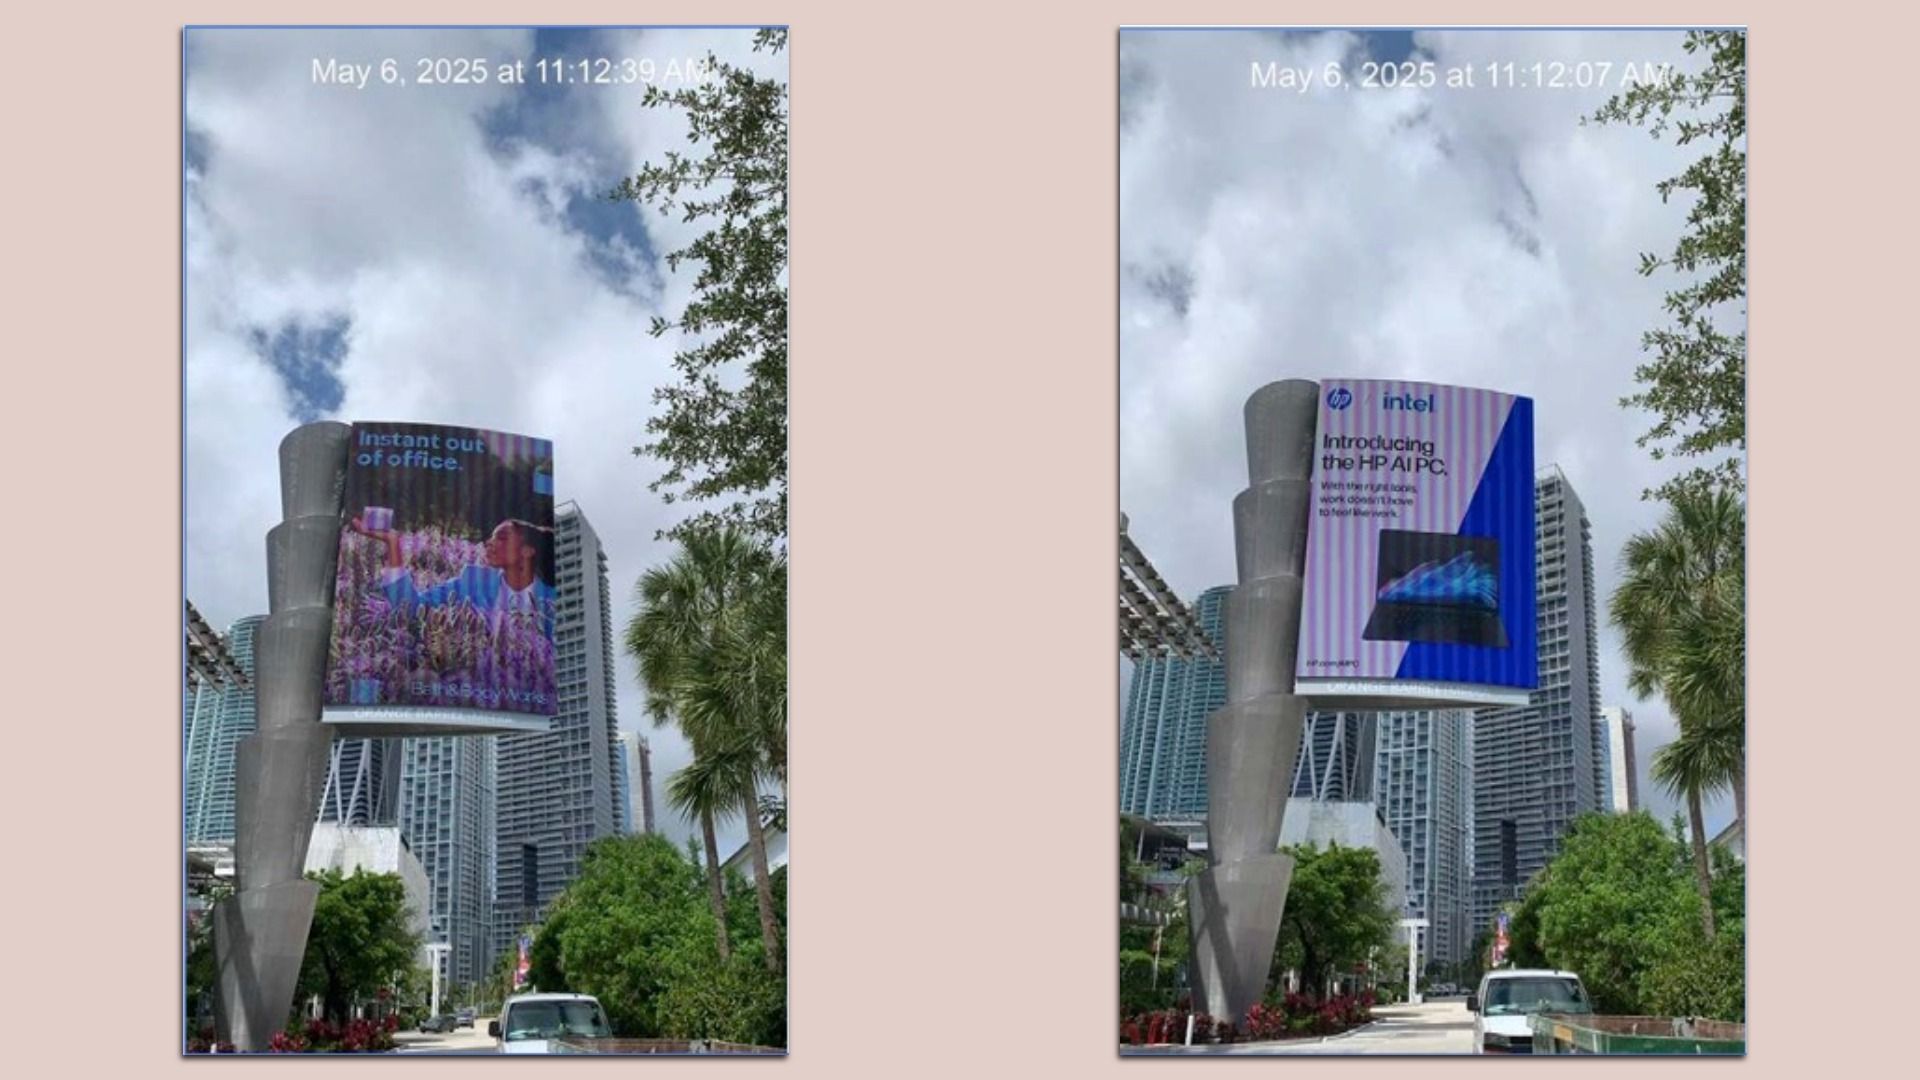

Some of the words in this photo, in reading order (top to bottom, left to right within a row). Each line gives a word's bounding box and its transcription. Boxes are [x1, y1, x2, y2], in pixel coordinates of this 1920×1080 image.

[359, 430, 440, 449] Instant
[445, 436, 485, 453] out
[1323, 433, 1435, 456] Introducing
[357, 450, 383, 466] of
[387, 451, 464, 471] office.
[1322, 454, 1355, 470] the
[1358, 455, 1388, 471] HP
[1391, 456, 1412, 473] AI
[1415, 459, 1448, 476] PC.
